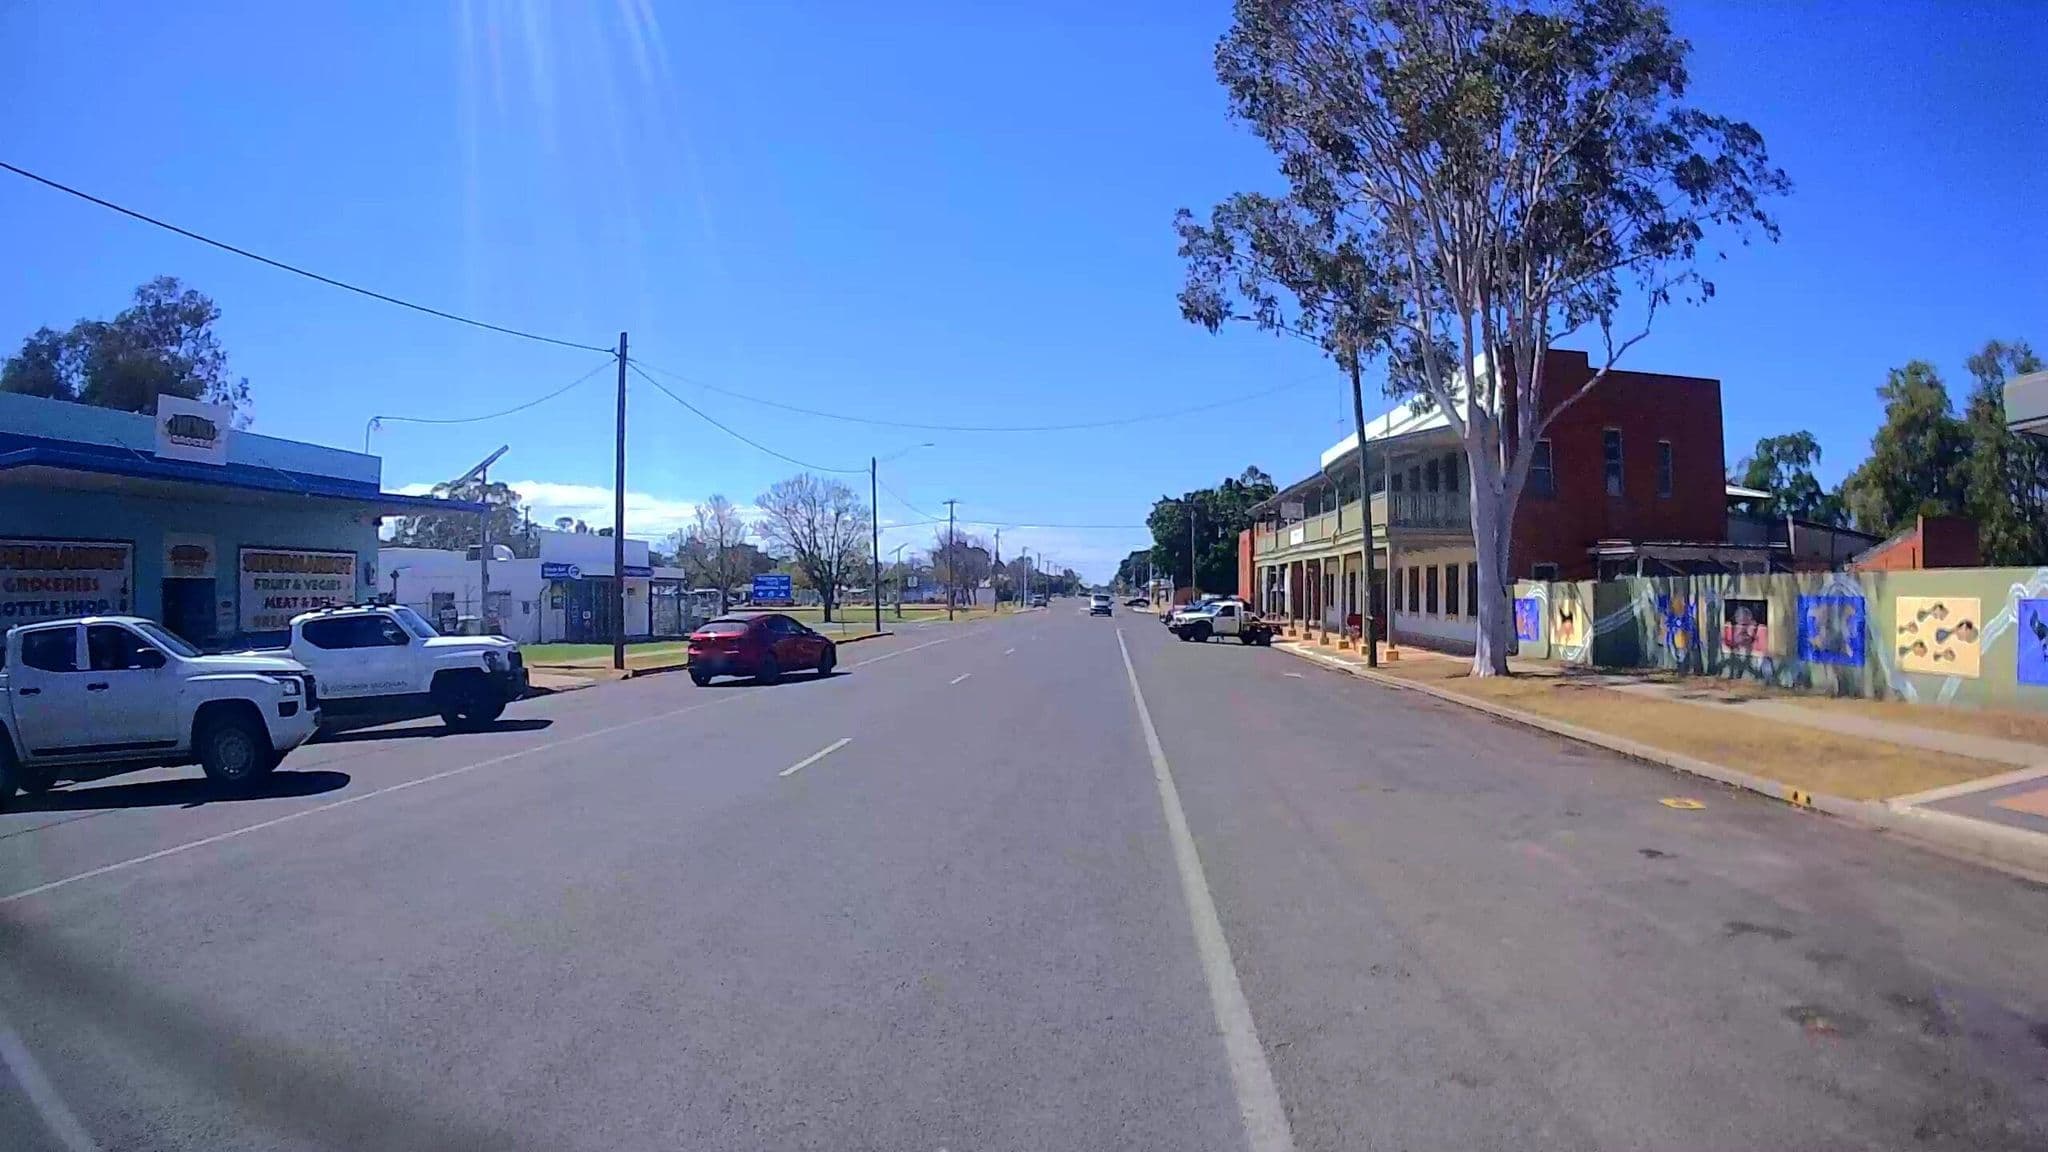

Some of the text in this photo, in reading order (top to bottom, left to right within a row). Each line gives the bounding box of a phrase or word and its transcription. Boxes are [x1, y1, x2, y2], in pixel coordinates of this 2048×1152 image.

[2, 577, 99, 592] GROCERIES
[254, 578, 290, 590] FRUIT
[0, 599, 110, 616] OTTLE SHOP
[265, 597, 298, 608] MEAT
